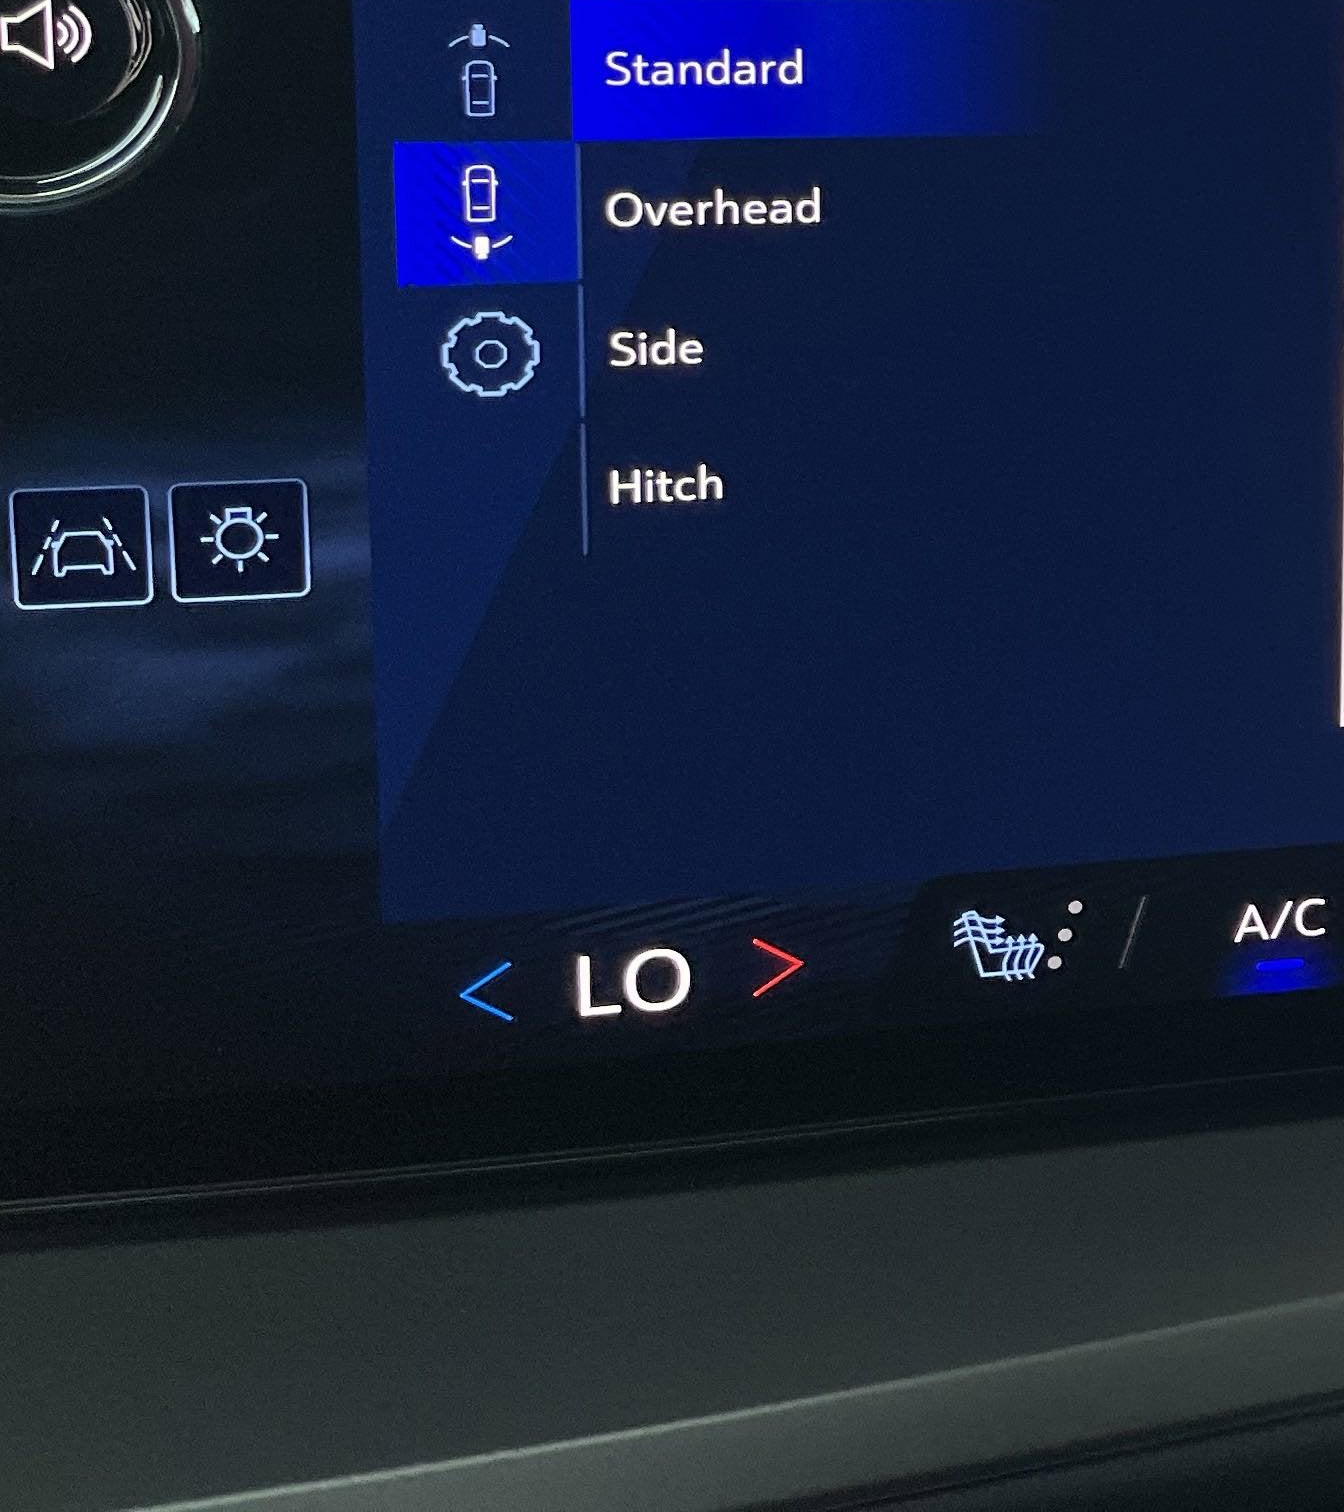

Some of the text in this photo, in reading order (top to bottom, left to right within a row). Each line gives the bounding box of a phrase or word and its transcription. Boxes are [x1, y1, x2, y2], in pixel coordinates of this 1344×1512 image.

[604, 46, 805, 88] Standard
[604, 184, 822, 228] Overhead
[608, 326, 705, 369] Side
[608, 462, 725, 506] Hitch
[1232, 897, 1328, 944] A/C
[574, 947, 693, 1019] LO
